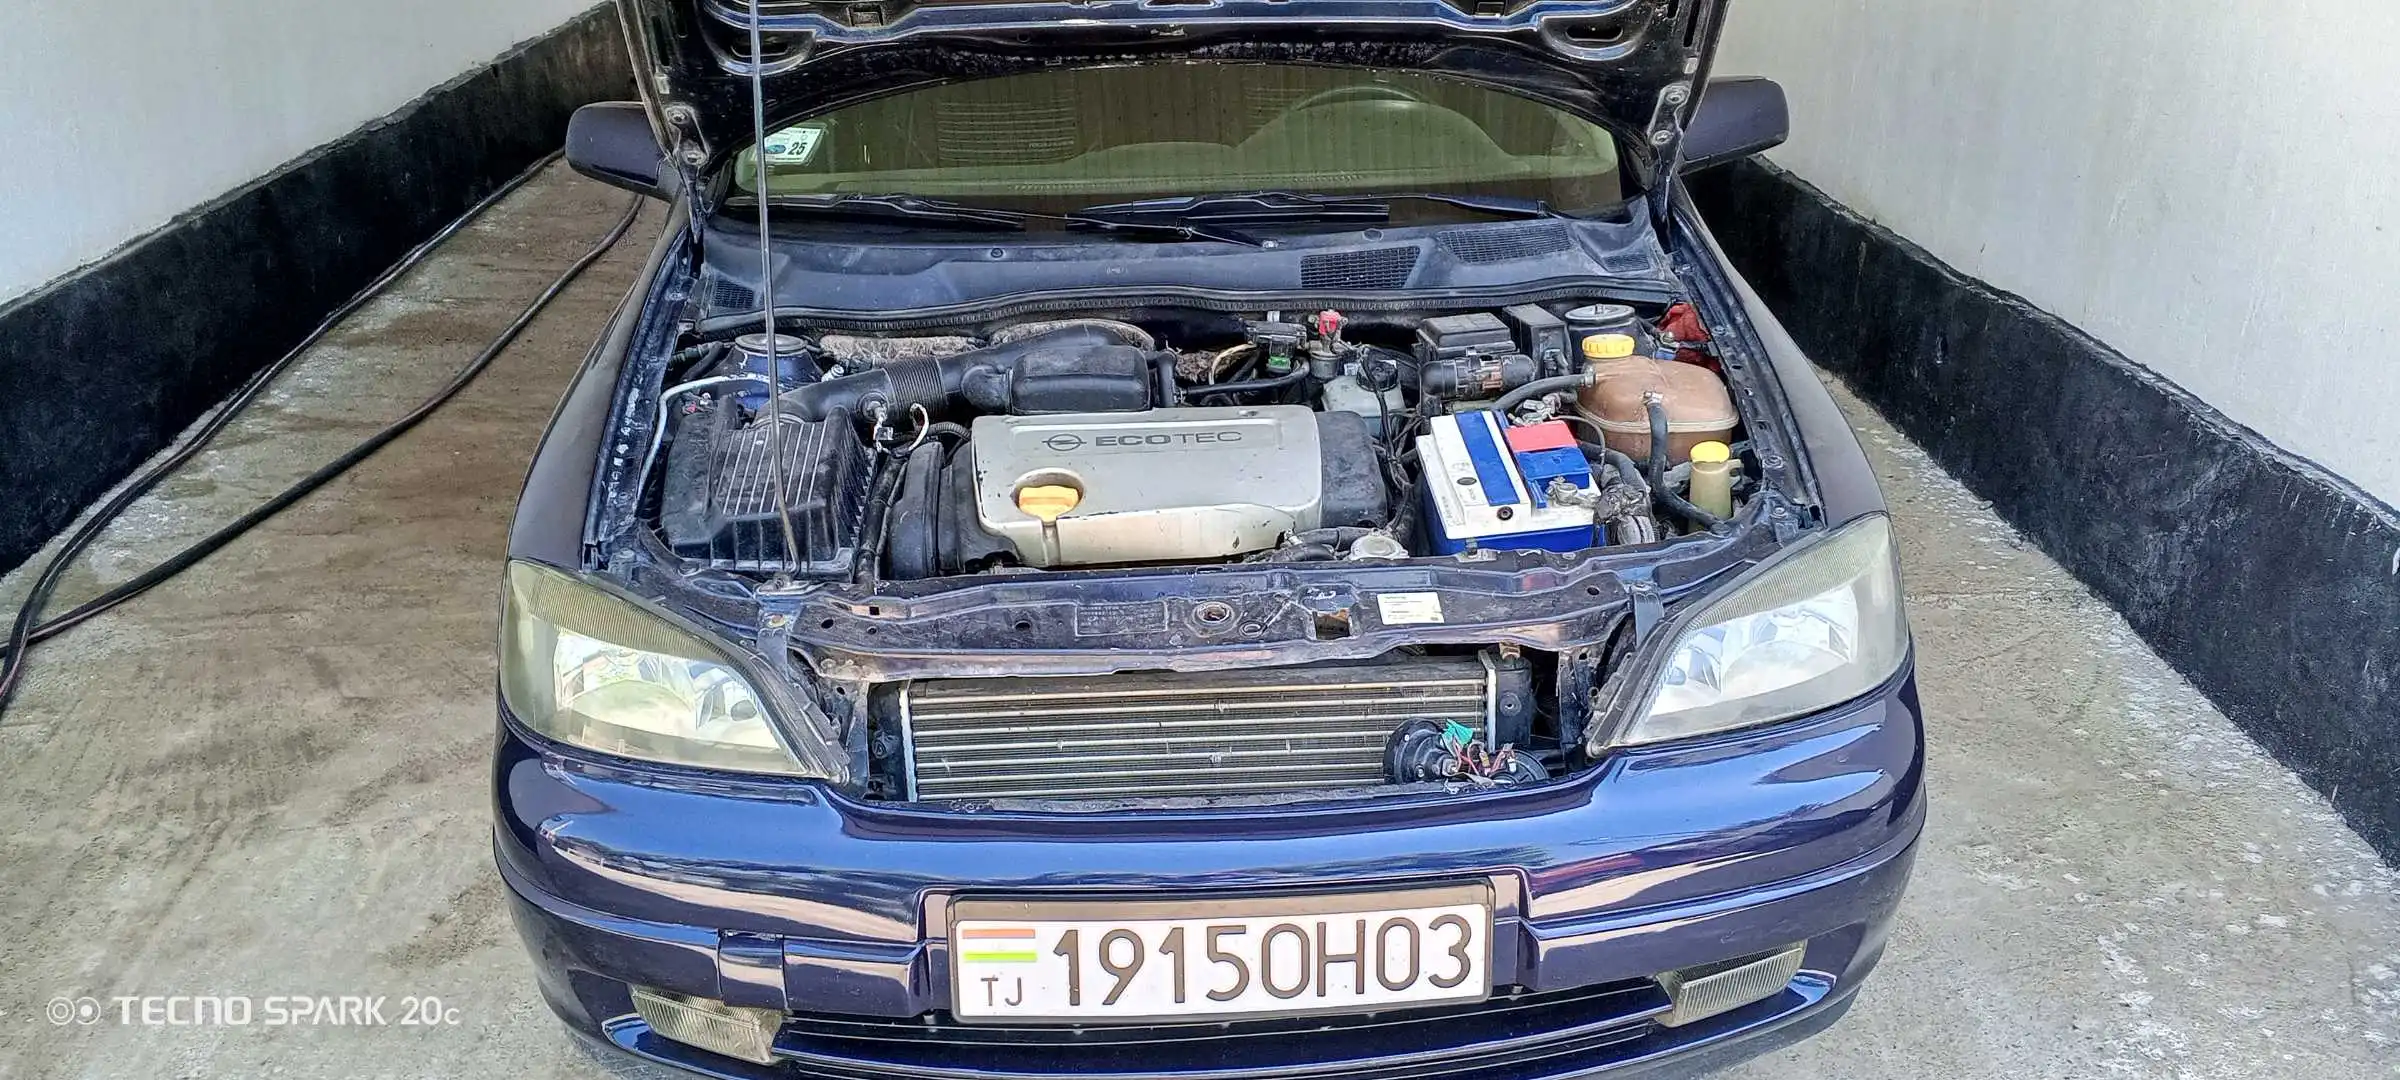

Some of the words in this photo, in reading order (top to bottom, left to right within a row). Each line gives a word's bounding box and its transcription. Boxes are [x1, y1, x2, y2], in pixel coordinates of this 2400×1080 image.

[788, 141, 807, 155] 25
[1095, 431, 1242, 447] ECOTEC
[980, 976, 1023, 1007] TJ
